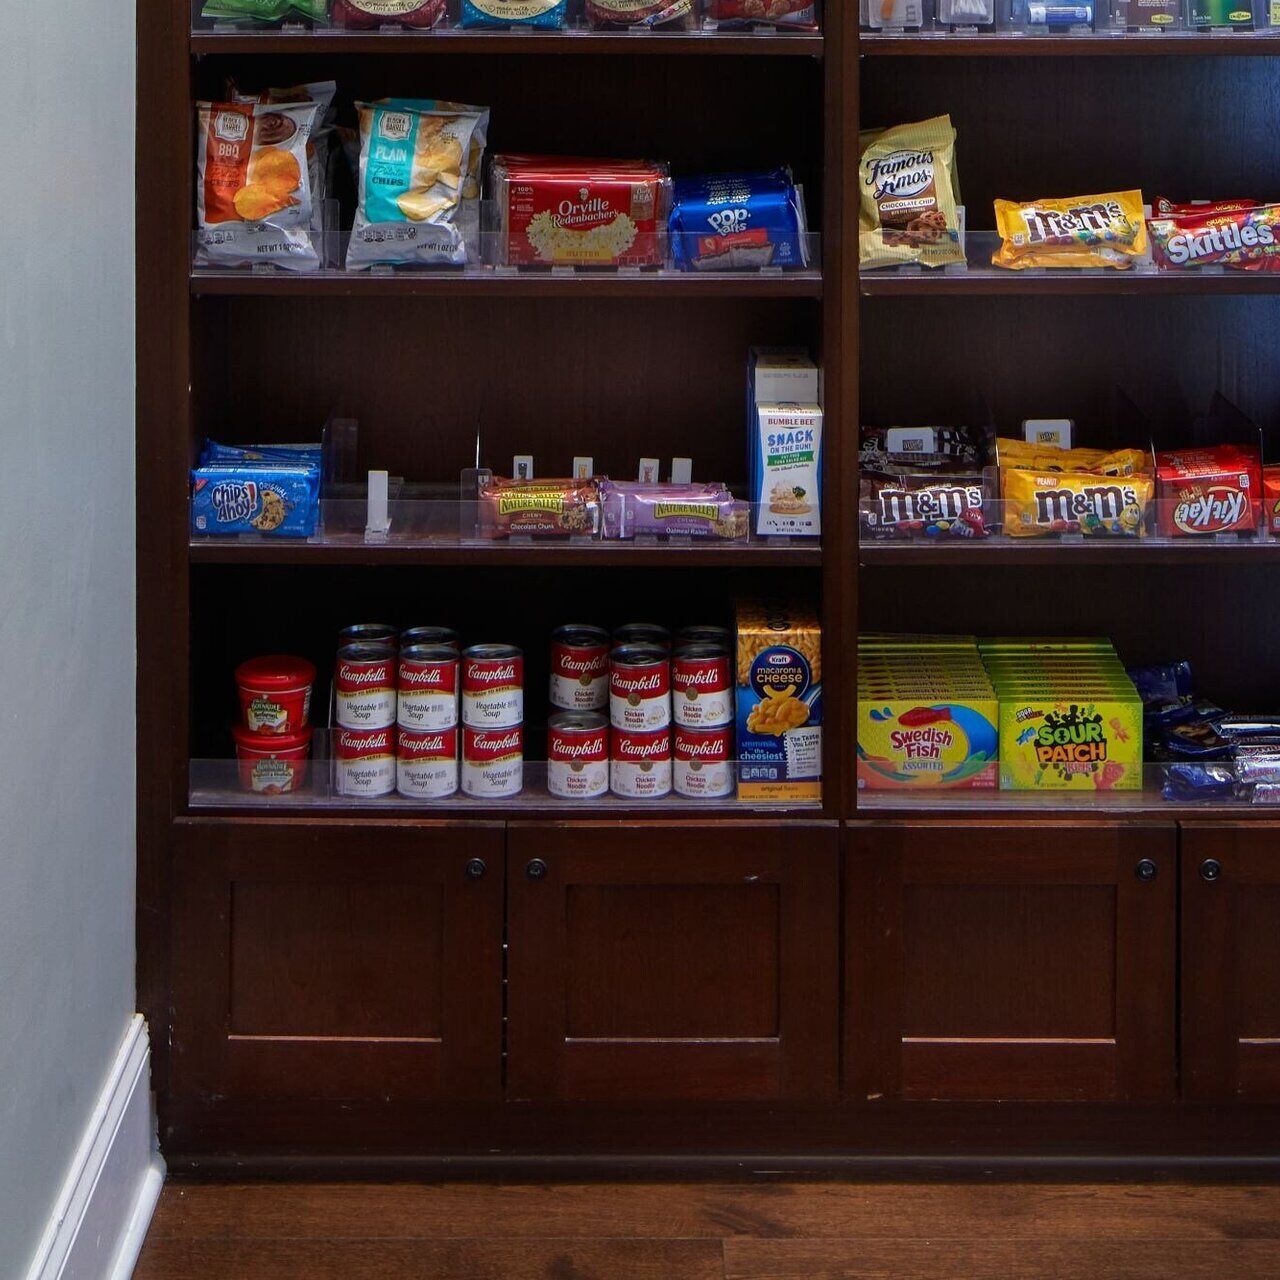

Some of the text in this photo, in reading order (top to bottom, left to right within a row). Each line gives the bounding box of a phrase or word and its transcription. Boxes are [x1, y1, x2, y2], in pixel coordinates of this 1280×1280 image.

[219, 144, 239, 158] BBQ
[375, 146, 407, 162] PLAIN
[865, 150, 933, 186] Famous
[372, 177, 404, 186] CHIPS
[873, 169, 929, 200] Amos
[559, 198, 609, 216] Orville
[881, 200, 917, 210] CHOCOLATE
[551, 208, 619, 229] Redenbacher's
[1026, 202, 1121, 242] m&m's
[1167, 222, 1275, 264] Skittles
[800, 418, 814, 426] BEE
[767, 430, 814, 447] SNACK
[1037, 477, 1057, 485] PEANUT
[212, 483, 249, 508] Chips
[217, 489, 257, 522] Ahoy!
[502, 499, 561, 512] NATURE VALLEY
[657, 504, 717, 518] NATURE VALLEY
[879, 486, 982, 525] m&m's
[1034, 485, 1137, 524] m&m's
[339, 664, 386, 684] Campbell's
[399, 664, 441, 684] Campbell's
[468, 664, 515, 683] Campbell's
[611, 672, 660, 692] Campbell's
[673, 667, 718, 686] Campbell's
[346, 701, 376, 712] Vegetable
[354, 709, 371, 718] Soup
[402, 702, 429, 713] Vegetable
[475, 700, 506, 712] Vegetable
[483, 709, 501, 718] Soup
[407, 710, 423, 720] Soup
[340, 732, 386, 749] Campbell's
[399, 731, 443, 751] Campbell's
[473, 731, 520, 751] Campbell's
[802, 734, 819, 743] Taste
[890, 728, 952, 749] Swedish
[1038, 723, 1101, 745] SOUR
[552, 738, 603, 757] Campbell's
[620, 737, 669, 757] Campbell's
[675, 737, 723, 755] Campbell's
[904, 742, 940, 759] Fish
[1037, 742, 1106, 762] PATCH
[740, 751, 783, 760] cheesiest
[347, 769, 378, 780] Vegetable
[482, 769, 512, 780] Vegetable
[903, 761, 943, 771] ASSORTED
[354, 778, 372, 786] Soup
[404, 770, 433, 781] Vegetable
[411, 779, 427, 788] Soup
[491, 777, 508, 786] Soup
